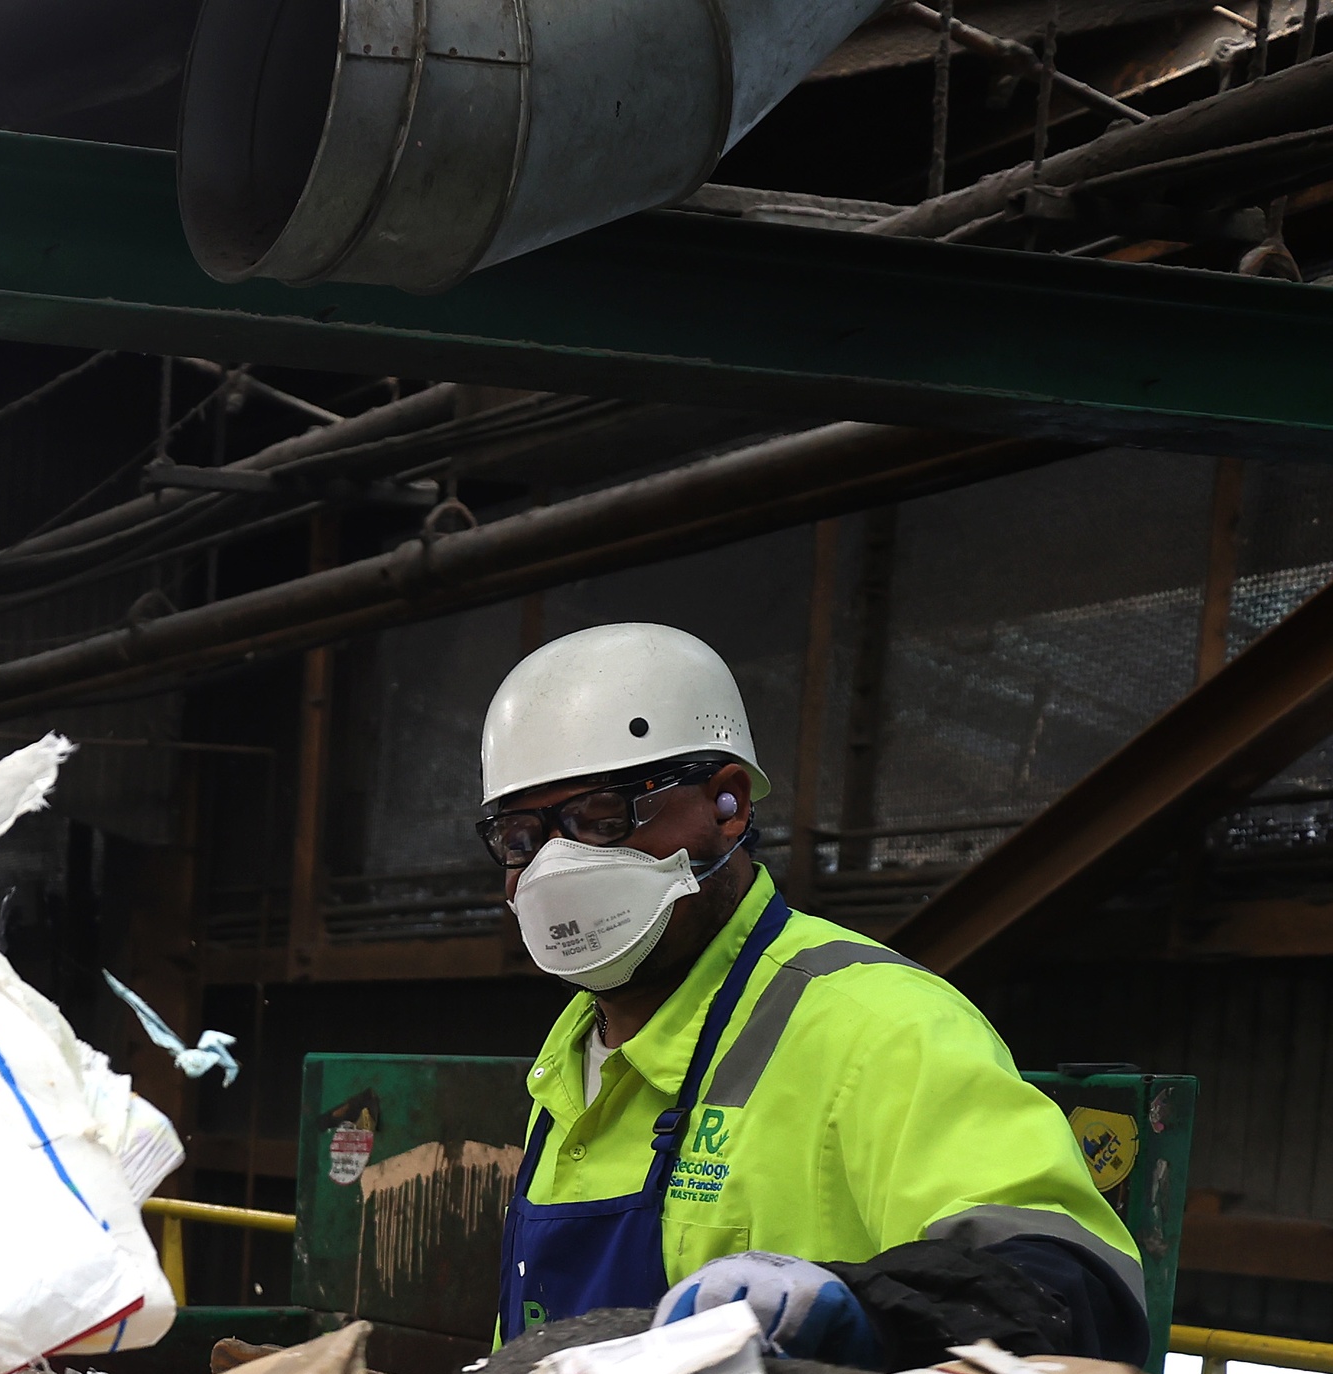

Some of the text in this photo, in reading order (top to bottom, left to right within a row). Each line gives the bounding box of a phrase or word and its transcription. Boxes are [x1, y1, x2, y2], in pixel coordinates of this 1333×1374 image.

[549, 920, 580, 940] 3M
[562, 944, 587, 956] NIOSH
[1094, 1135, 1121, 1174] MCCT
[673, 1158, 729, 1180] Recology
[670, 1175, 684, 1187] San
[670, 1189, 698, 1201] WASTE
